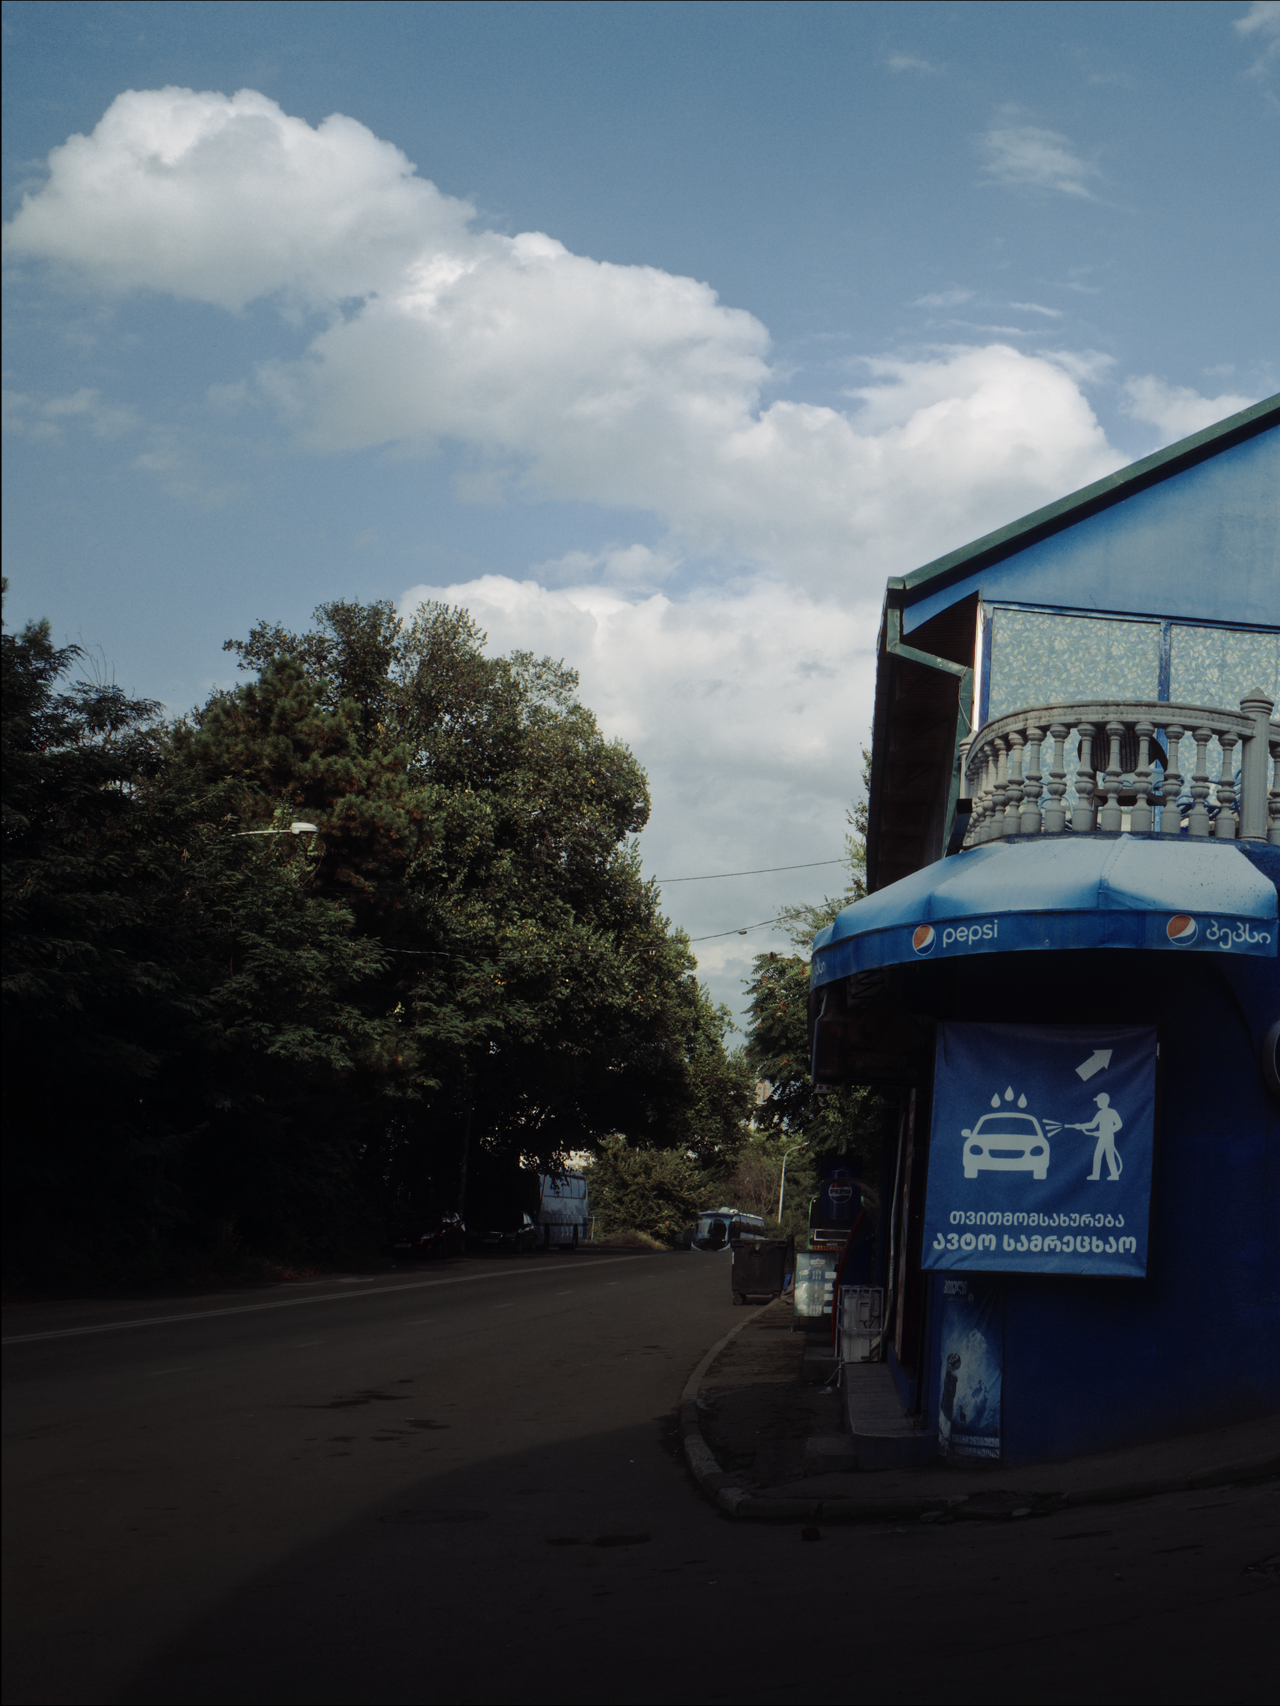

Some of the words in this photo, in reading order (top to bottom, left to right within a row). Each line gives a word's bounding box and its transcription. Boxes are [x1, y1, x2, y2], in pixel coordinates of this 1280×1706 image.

[942, 919, 999, 948] pepsi
[1205, 919, 1271, 949] პეპსი
[949, 1210, 1125, 1228] თვითმომსახურება
[932, 1232, 997, 1251] ავტო
[1003, 1234, 1137, 1254] სამრეცხაო
